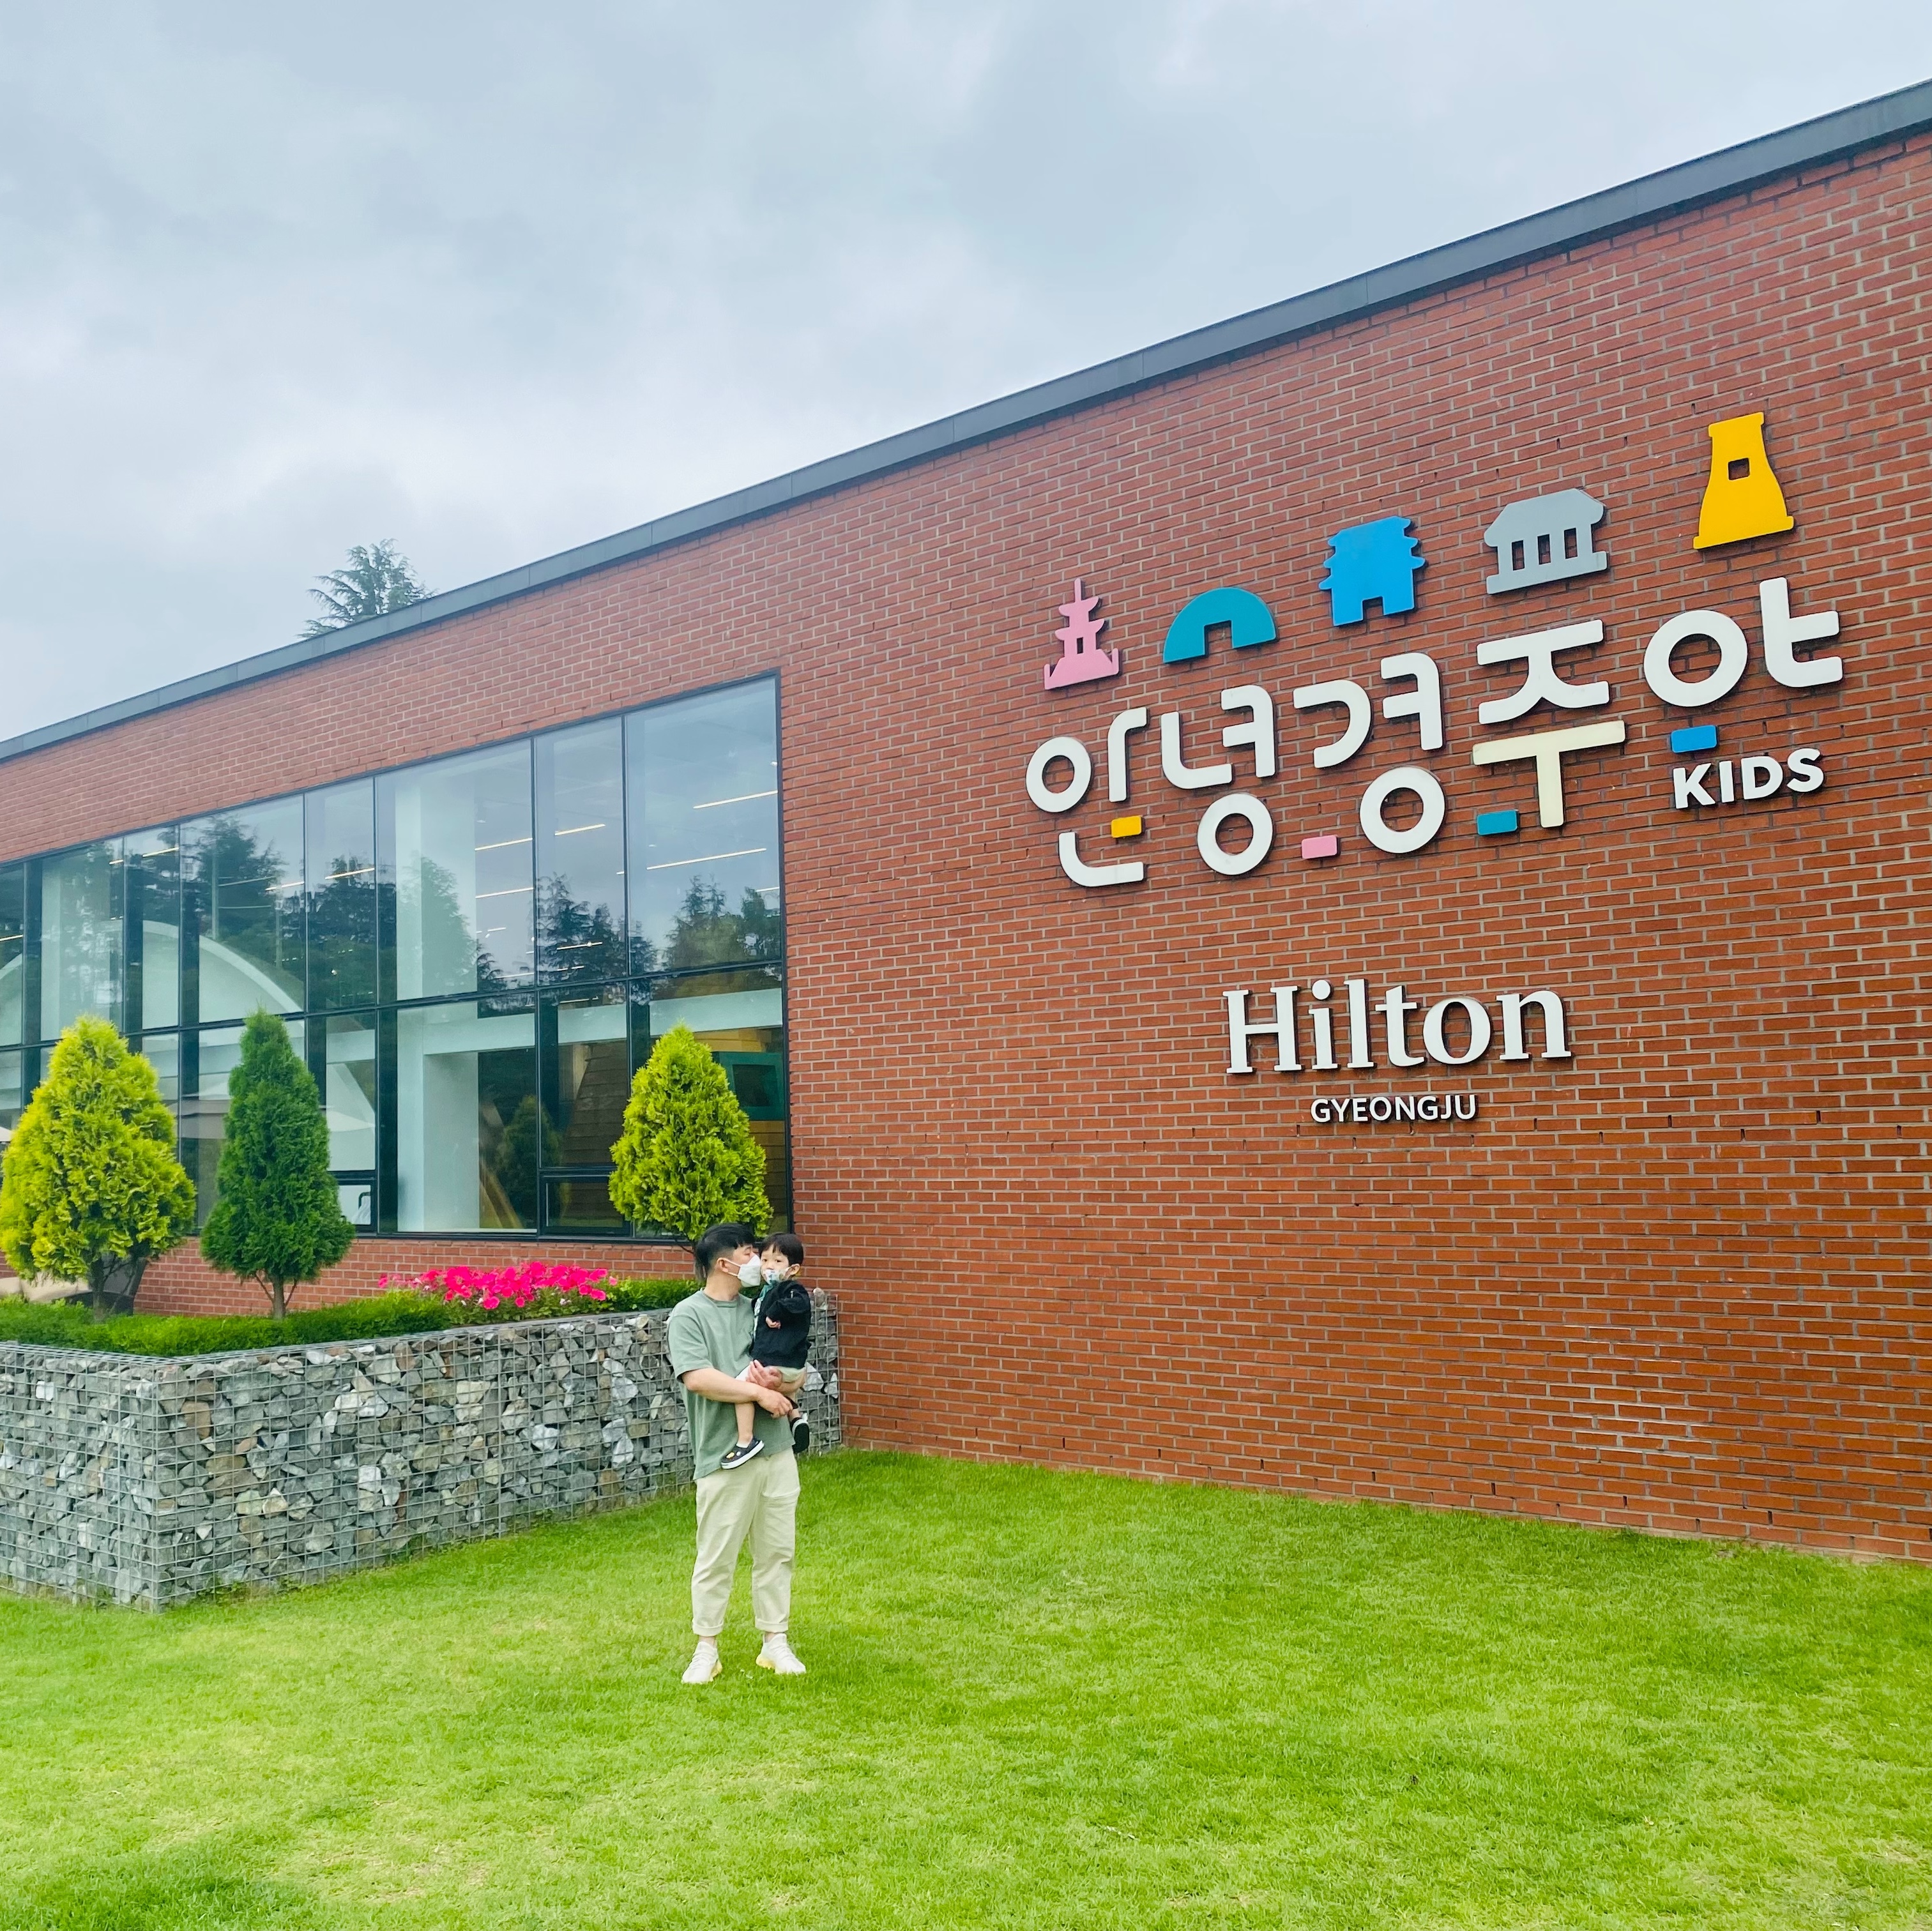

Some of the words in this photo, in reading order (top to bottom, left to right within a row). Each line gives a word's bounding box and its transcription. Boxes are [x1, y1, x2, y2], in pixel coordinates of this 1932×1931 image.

[1672, 747, 1825, 810] KIDS
[1222, 978, 1572, 1074] Hilton
[1309, 1093, 1477, 1123] GYEONGJU
